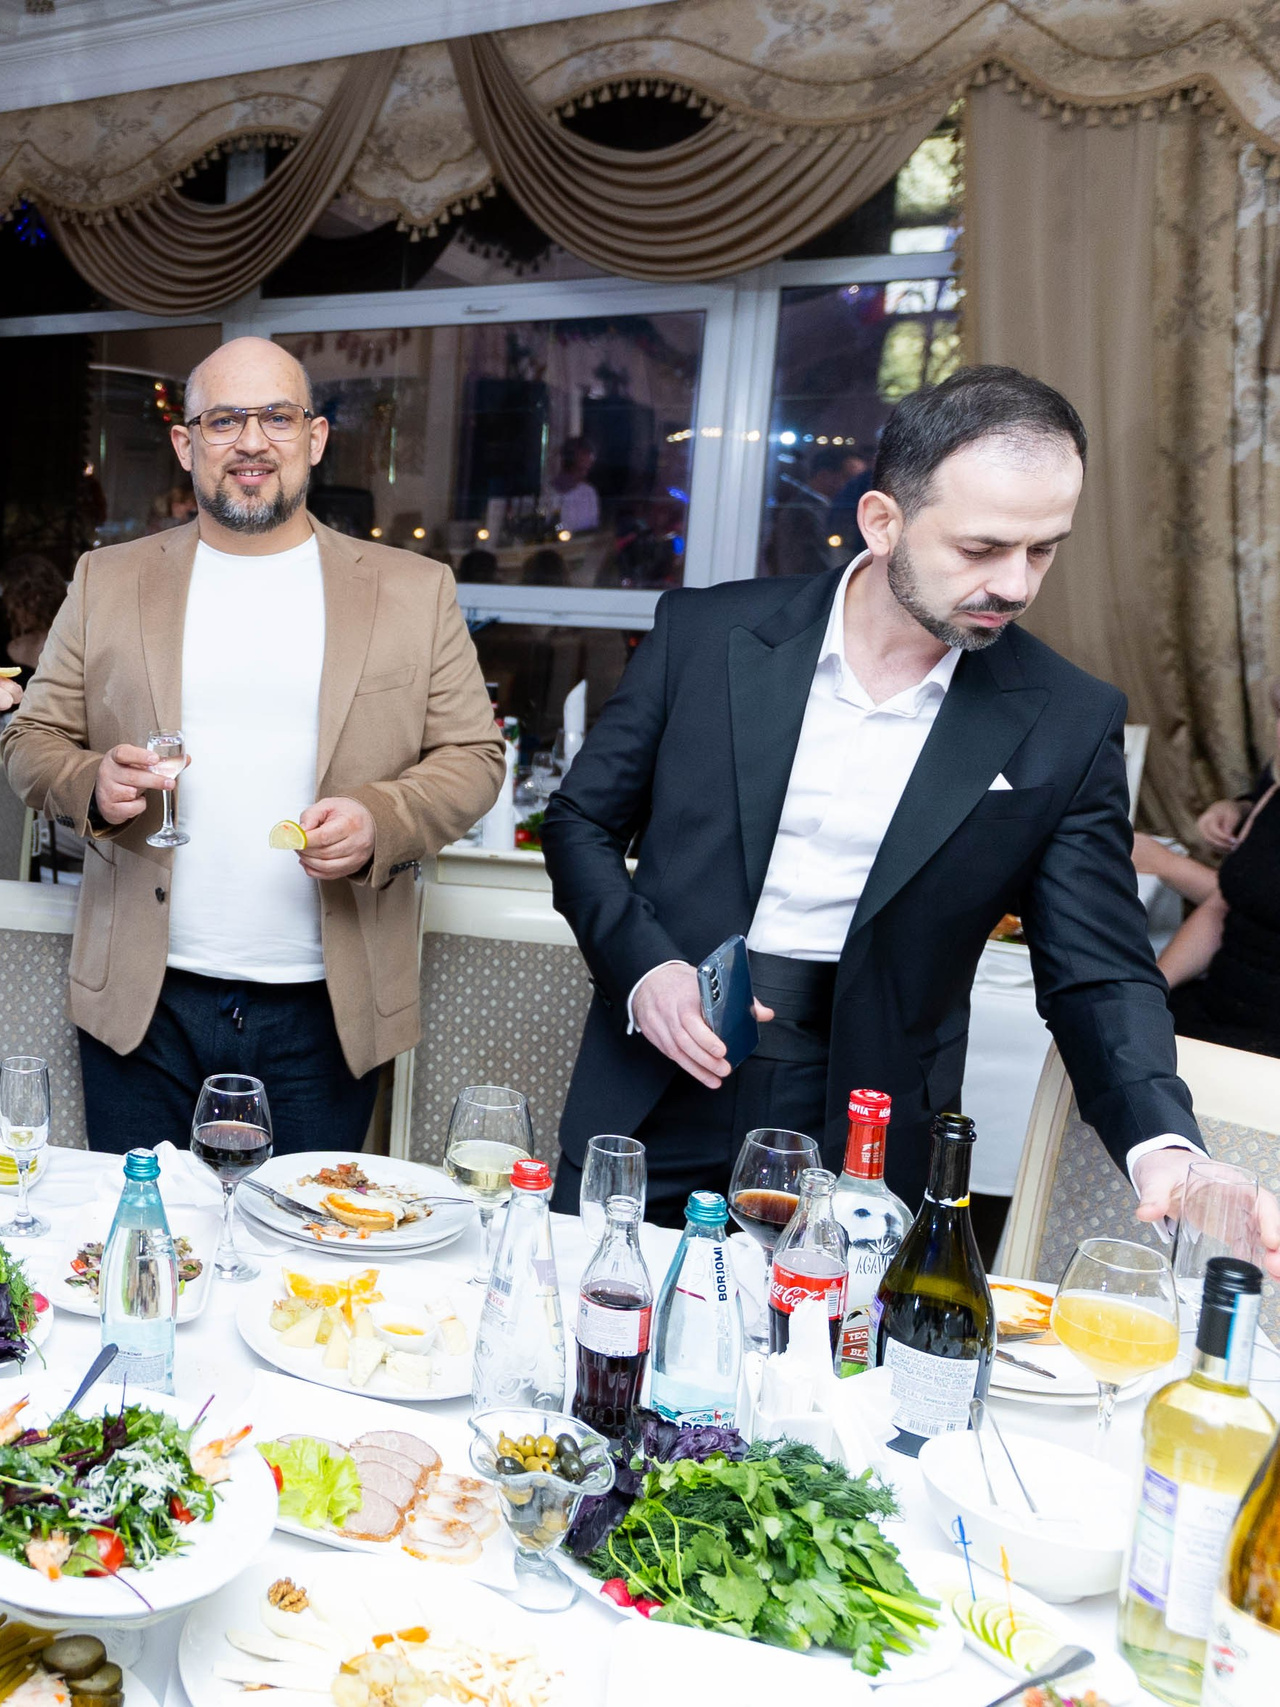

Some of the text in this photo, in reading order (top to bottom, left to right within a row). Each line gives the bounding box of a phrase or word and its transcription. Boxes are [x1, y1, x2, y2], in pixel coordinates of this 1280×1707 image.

[713, 1247, 728, 1301] BORJOMI
[855, 1255, 892, 1275] AGAVI
[848, 1332, 868, 1341] TEQ
